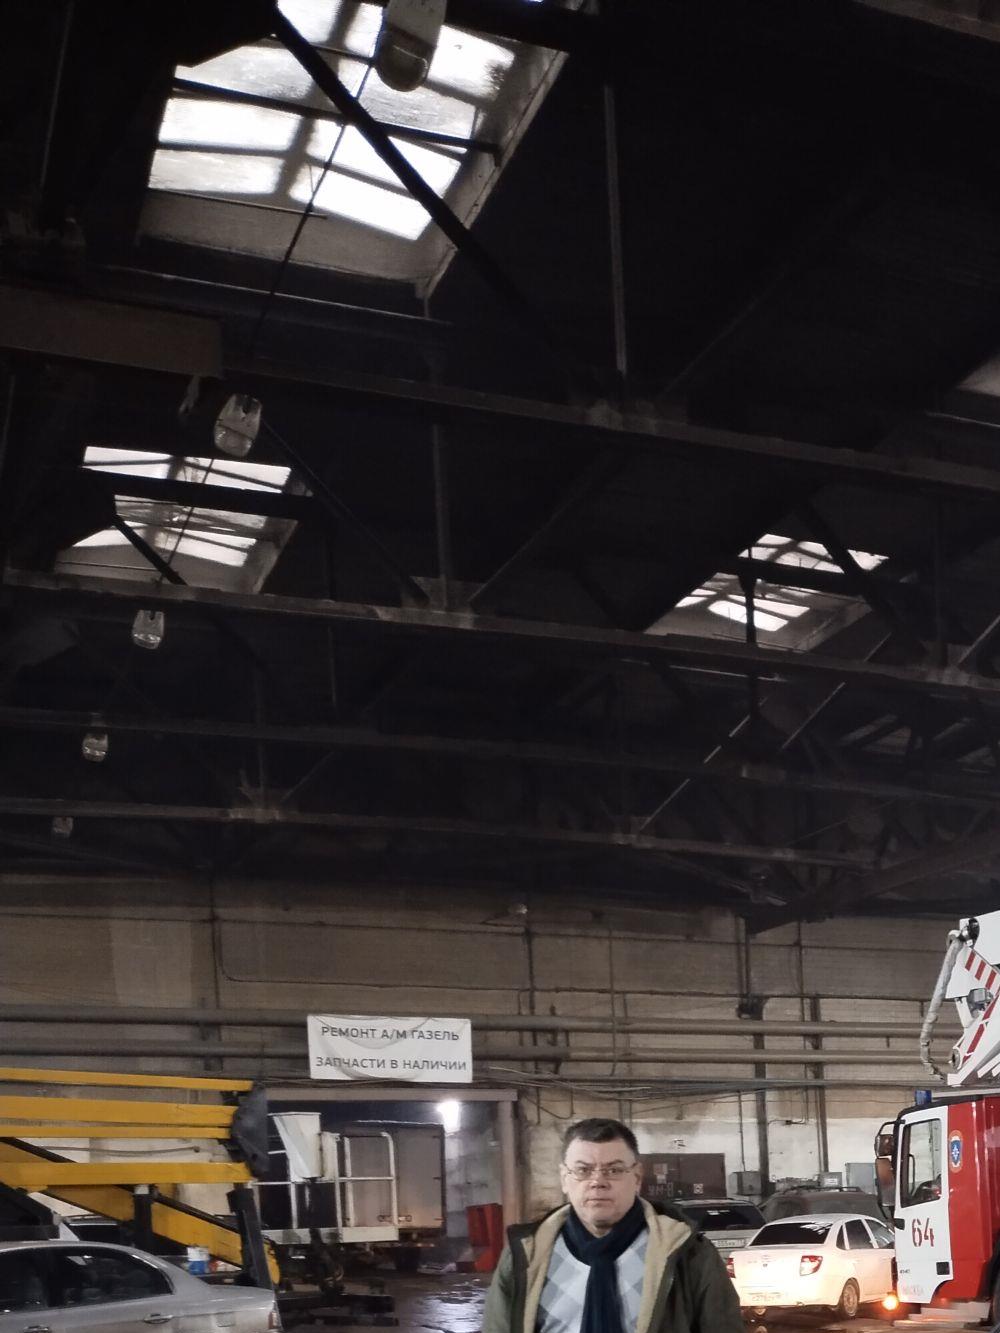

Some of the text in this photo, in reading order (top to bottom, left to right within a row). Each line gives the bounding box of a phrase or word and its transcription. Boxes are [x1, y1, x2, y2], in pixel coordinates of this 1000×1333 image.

[321, 1026, 460, 1041] РЕМОНТ А/М ГАЗЕЛЬ
[316, 1056, 467, 1071] ЗАПЧАСТИ В НАЛИЧИИ
[912, 1217, 935, 1248] 64
